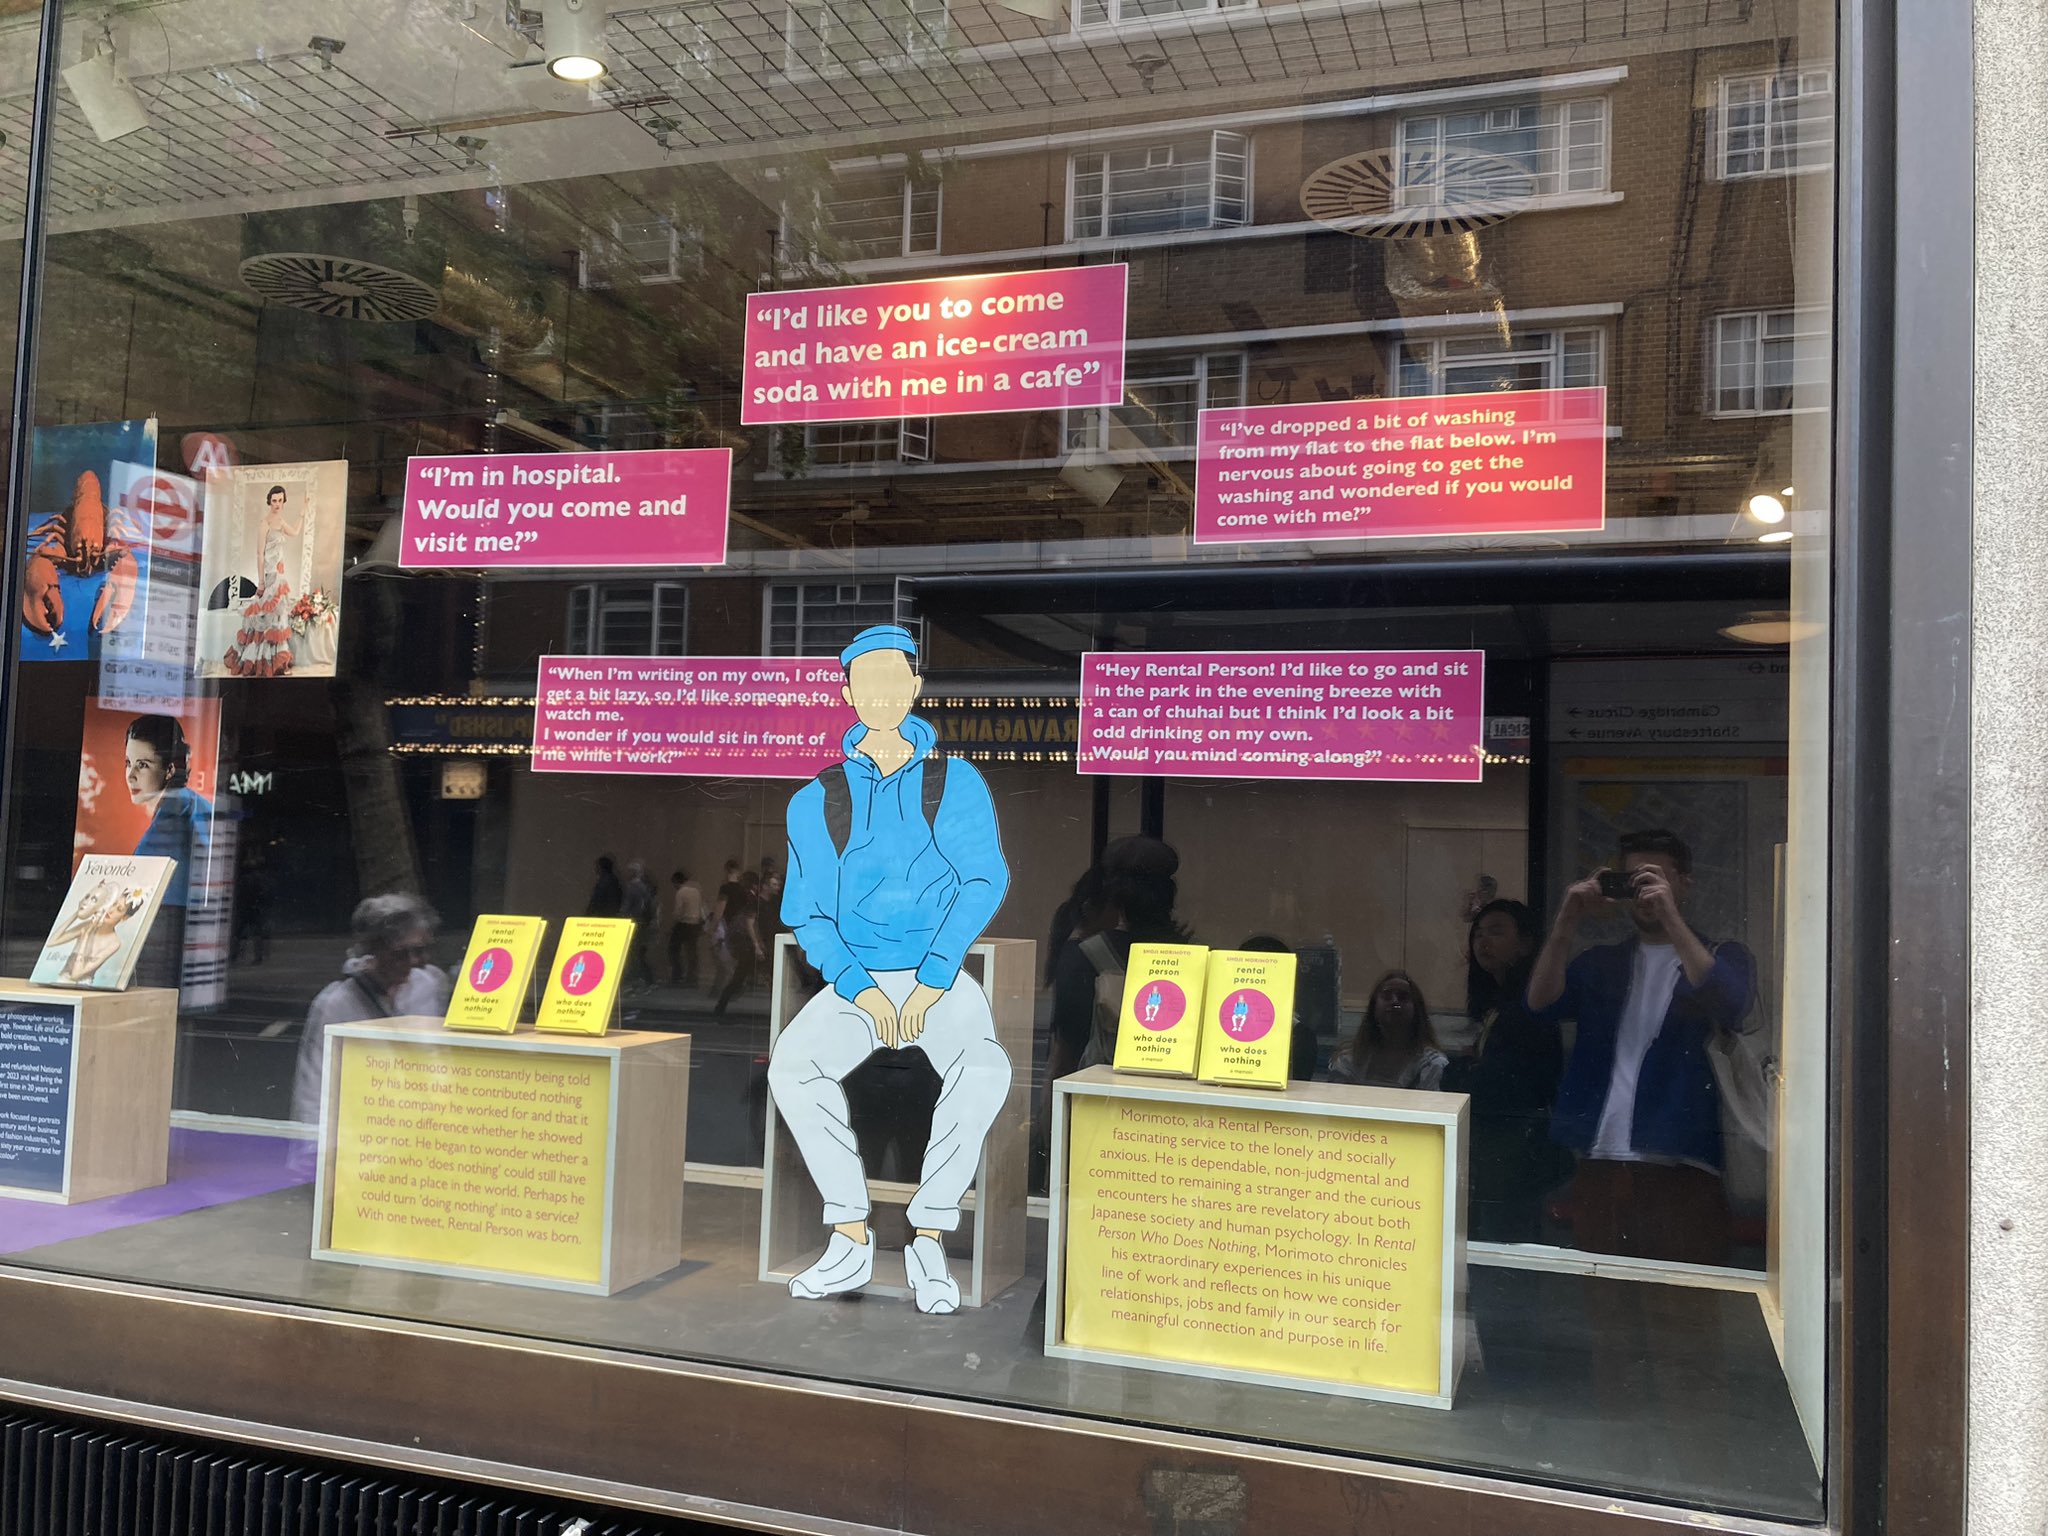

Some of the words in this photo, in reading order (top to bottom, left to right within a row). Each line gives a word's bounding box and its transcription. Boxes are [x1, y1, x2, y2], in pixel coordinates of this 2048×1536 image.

[817, 305, 868, 327] like
[877, 302, 931, 330] you
[939, 296, 972, 319] to
[981, 291, 1064, 316] come
[755, 343, 806, 368] and
[816, 340, 882, 364] have
[891, 337, 927, 359] an
[937, 328, 1088, 357] ice-cream
[753, 380, 818, 405] soda
[827, 375, 892, 400] with
[901, 372, 947, 396] me
[957, 370, 983, 393] in
[993, 374, 1011, 391] a
[1270, 417, 1351, 437] dropped
[1357, 418, 1368, 431] a
[1373, 413, 1401, 430] bit
[1407, 411, 1428, 427] of
[1433, 409, 1516, 427] washing
[1219, 445, 1265, 460] from
[1270, 444, 1299, 460] my
[1305, 440, 1338, 455] flat
[1344, 440, 1365, 453] to
[1371, 436, 1405, 452] the
[1410, 434, 1444, 450] flat
[1450, 431, 1515, 448] below.
[482, 466, 504, 486] in
[512, 463, 621, 490] hospital.
[1219, 466, 1294, 482] nervous
[1299, 461, 1357, 479] about
[1362, 461, 1416, 479] going
[1422, 458, 1445, 473] to
[1450, 457, 1484, 474] get
[1489, 455, 1524, 470] the
[1218, 489, 1294, 506] washing
[1299, 485, 1335, 501] and
[1340, 481, 1439, 499] wondered
[1445, 479, 1459, 495] if
[1465, 480, 1502, 497] you
[1510, 475, 1574, 493] would
[418, 498, 500, 520] Would
[508, 502, 553, 524] you
[561, 499, 631, 518] come
[639, 495, 687, 516] and
[1217, 512, 1268, 527] come
[1274, 507, 1317, 524] with
[415, 532, 467, 552] visit
[638, 668, 693, 685] writing
[698, 670, 718, 682] on
[722, 670, 747, 685] my
[751, 671, 790, 684] own,
[795, 669, 800, 682] I
[1145, 662, 1202, 677] Rental
[1208, 663, 1275, 677] Person!
[1309, 661, 1343, 676] like
[1349, 664, 1369, 677] to
[1374, 665, 1397, 680] go
[1402, 661, 1438, 676] and
[1444, 662, 1469, 676] sit
[1095, 684, 1111, 697] in
[1115, 684, 1145, 698] the
[1149, 685, 1190, 701] park
[1196, 685, 1212, 698] in
[1217, 684, 1248, 698] the
[1253, 685, 1324, 702] evening
[1329, 685, 1393, 698] breeze
[1398, 685, 1441, 698] with
[545, 708, 593, 721] watch
[596, 710, 624, 721] me.
[544, 729, 549, 740] I
[554, 729, 613, 742] wonder
[617, 729, 629, 742] if
[632, 731, 662, 746] you
[667, 730, 714, 744] would
[719, 731, 738, 744] sit
[743, 732, 758, 744] in
[762, 731, 805, 745] front
[809, 733, 825, 745] of
[1093, 726, 1125, 741] odd
[1130, 726, 1203, 744] drinking
[1208, 729, 1231, 741] on
[1236, 729, 1273, 745] my
[1269, 729, 1313, 742] own.
[84, 860, 136, 877] Yevonde
[1149, 968, 1179, 976] person
[1234, 977, 1266, 985] person
[464, 1005, 492, 1014] nothing
[1136, 1045, 1171, 1054] nothing
[1156, 1036, 1177, 1044] does
[1220, 1045, 1241, 1054] who
[1244, 1047, 1267, 1055] does
[366, 1056, 391, 1070] Shoji
[394, 1058, 448, 1074] Morimoto
[451, 1065, 472, 1075] was
[475, 1067, 532, 1084] constantly
[534, 1070, 564, 1087] being
[568, 1074, 590, 1086] told
[1224, 1057, 1261, 1067] nothing
[1121, 1108, 1188, 1128] Morimoto,
[1193, 1116, 1214, 1129] aka
[1218, 1117, 1259, 1133] Rental
[1264, 1121, 1312, 1139] Person,
[1317, 1128, 1376, 1144] provides
[1380, 1134, 1388, 1145] a
[1112, 1128, 1178, 1148] fascinating
[1181, 1137, 1226, 1150] service
[1230, 1139, 1244, 1151] to
[1248, 1139, 1270, 1154] the
[1274, 1143, 1313, 1162] lonely
[1318, 1146, 1343, 1161] and
[1347, 1150, 1396, 1169] socially
[357, 1207, 384, 1221] With
[387, 1212, 407, 1223] one
[411, 1213, 445, 1229] tweet,
[448, 1217, 482, 1233] Rental
[486, 1222, 523, 1238] Person
[527, 1229, 548, 1240] was
[551, 1230, 582, 1245] born.
